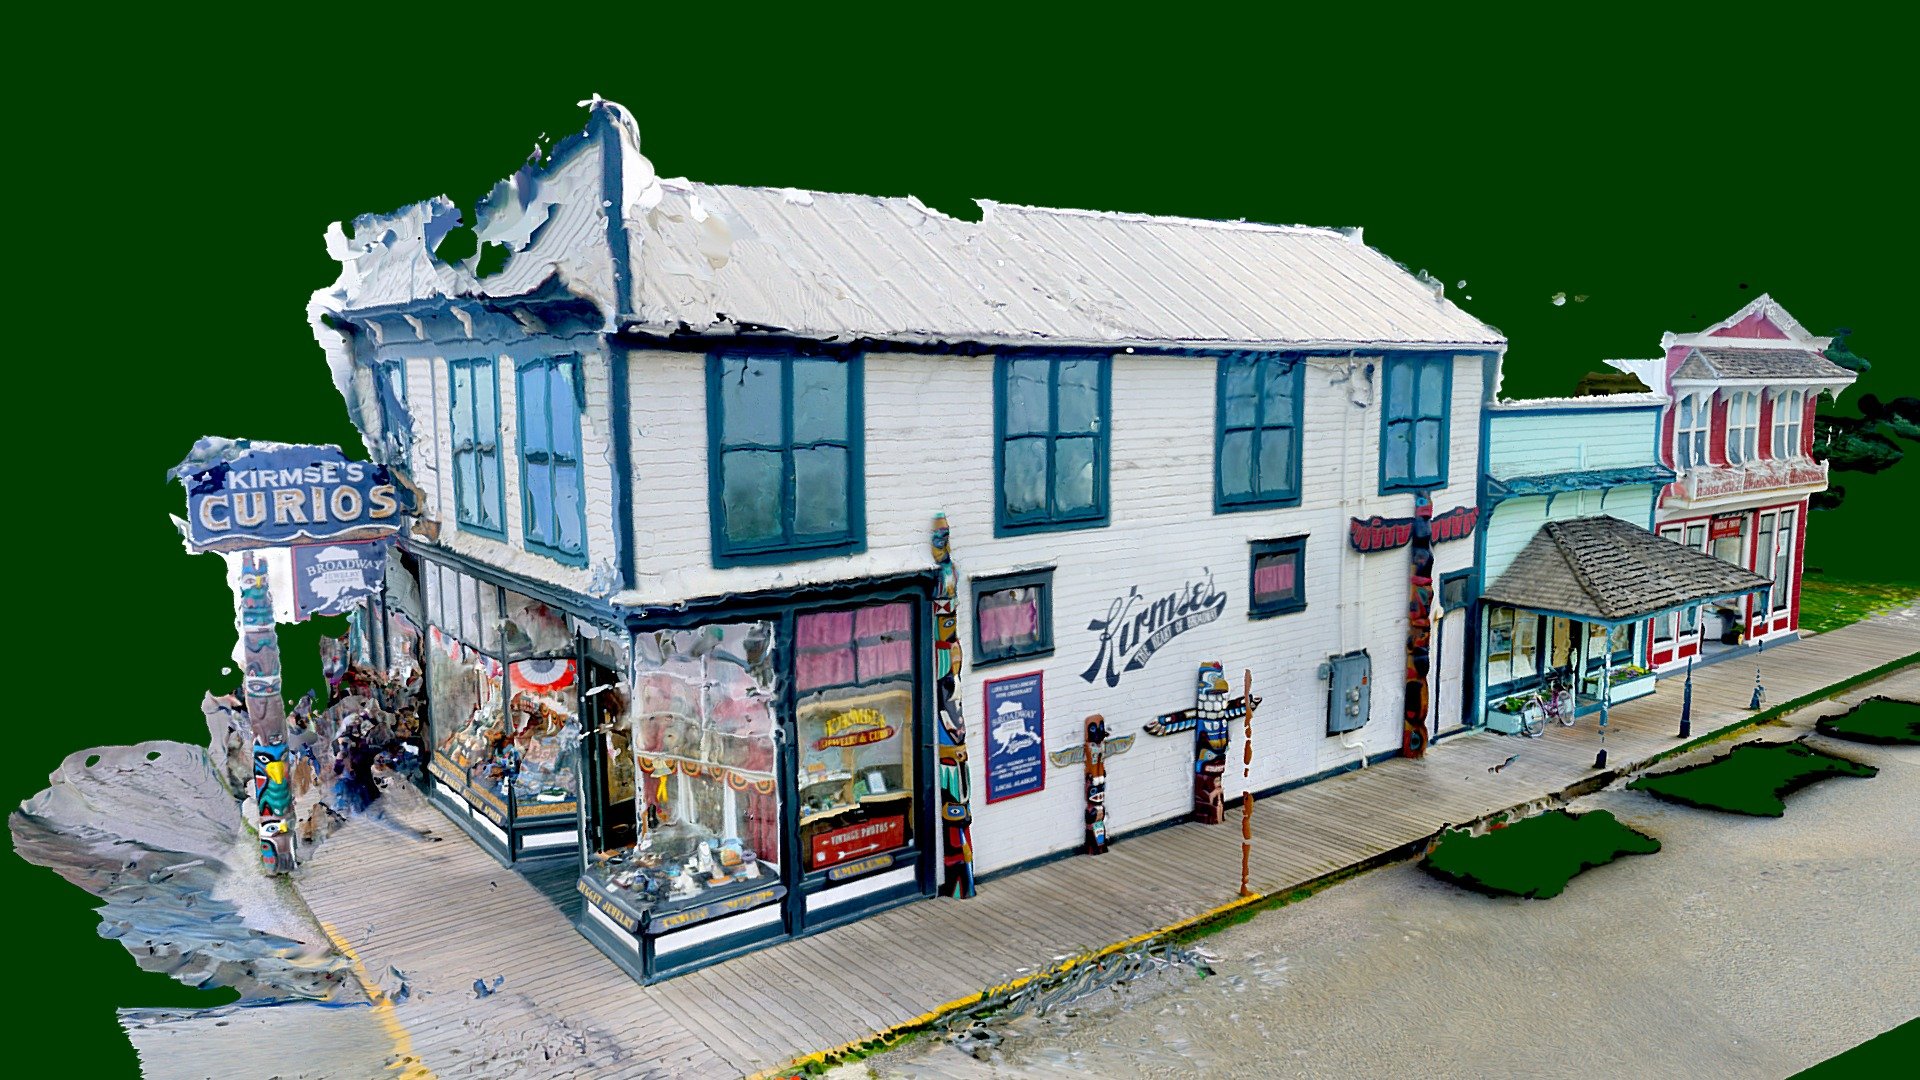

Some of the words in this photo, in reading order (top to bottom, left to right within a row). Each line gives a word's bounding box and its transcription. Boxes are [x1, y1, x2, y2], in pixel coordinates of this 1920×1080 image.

[229, 460, 364, 489] KIRMSE'S
[200, 485, 397, 531] CURIOS
[306, 559, 384, 577] BROADWAY
[992, 710, 1037, 728] BROADWAY
[861, 821, 889, 838] PHOTOS
